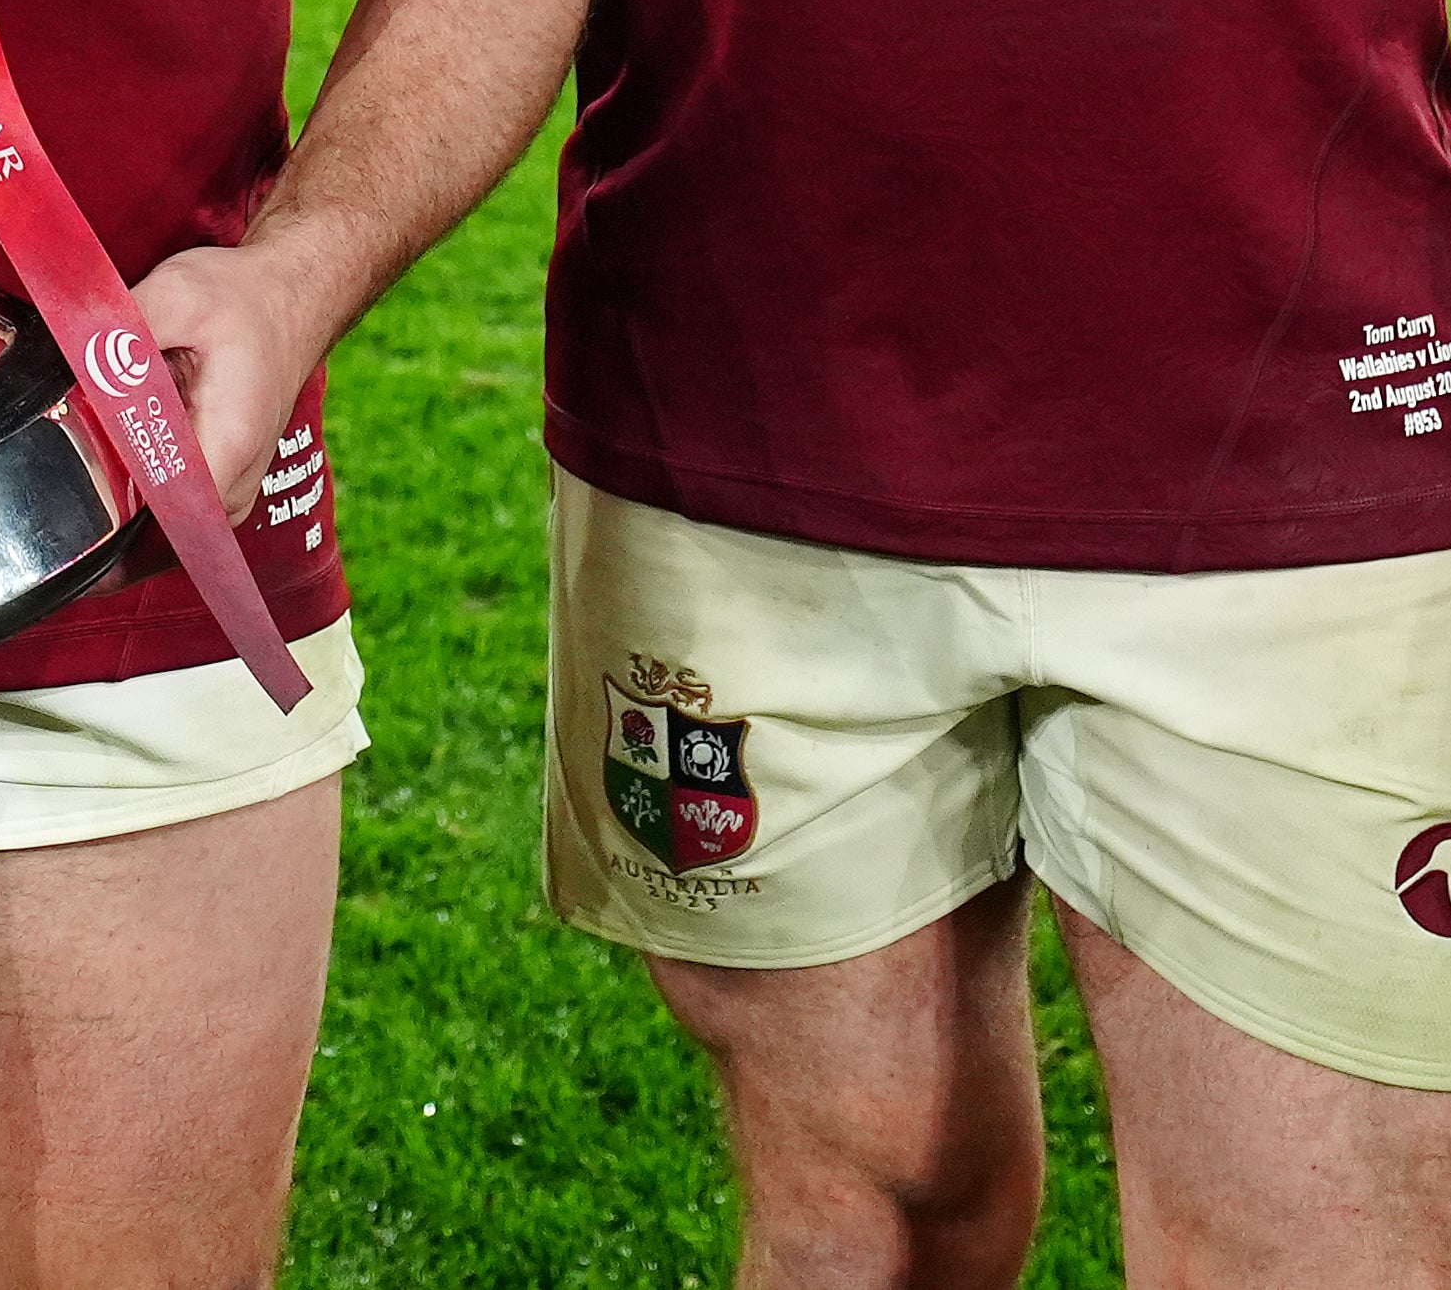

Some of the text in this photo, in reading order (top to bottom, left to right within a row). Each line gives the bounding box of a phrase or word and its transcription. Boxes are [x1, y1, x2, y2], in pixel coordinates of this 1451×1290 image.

[1363, 314, 1436, 346] Tom Curry
[1339, 350, 1416, 381] Wallabies
[1416, 348, 1427, 367] v
[1349, 386, 1383, 413] 2nd
[1386, 380, 1437, 408] August
[147, 396, 186, 475] QATAR
[1404, 408, 1443, 436] #853
[125, 406, 168, 484] LIONS
[268, 499, 291, 526] 2nd
[610, 853, 761, 894] AUSTRALIA
[648, 884, 718, 912] 2025
